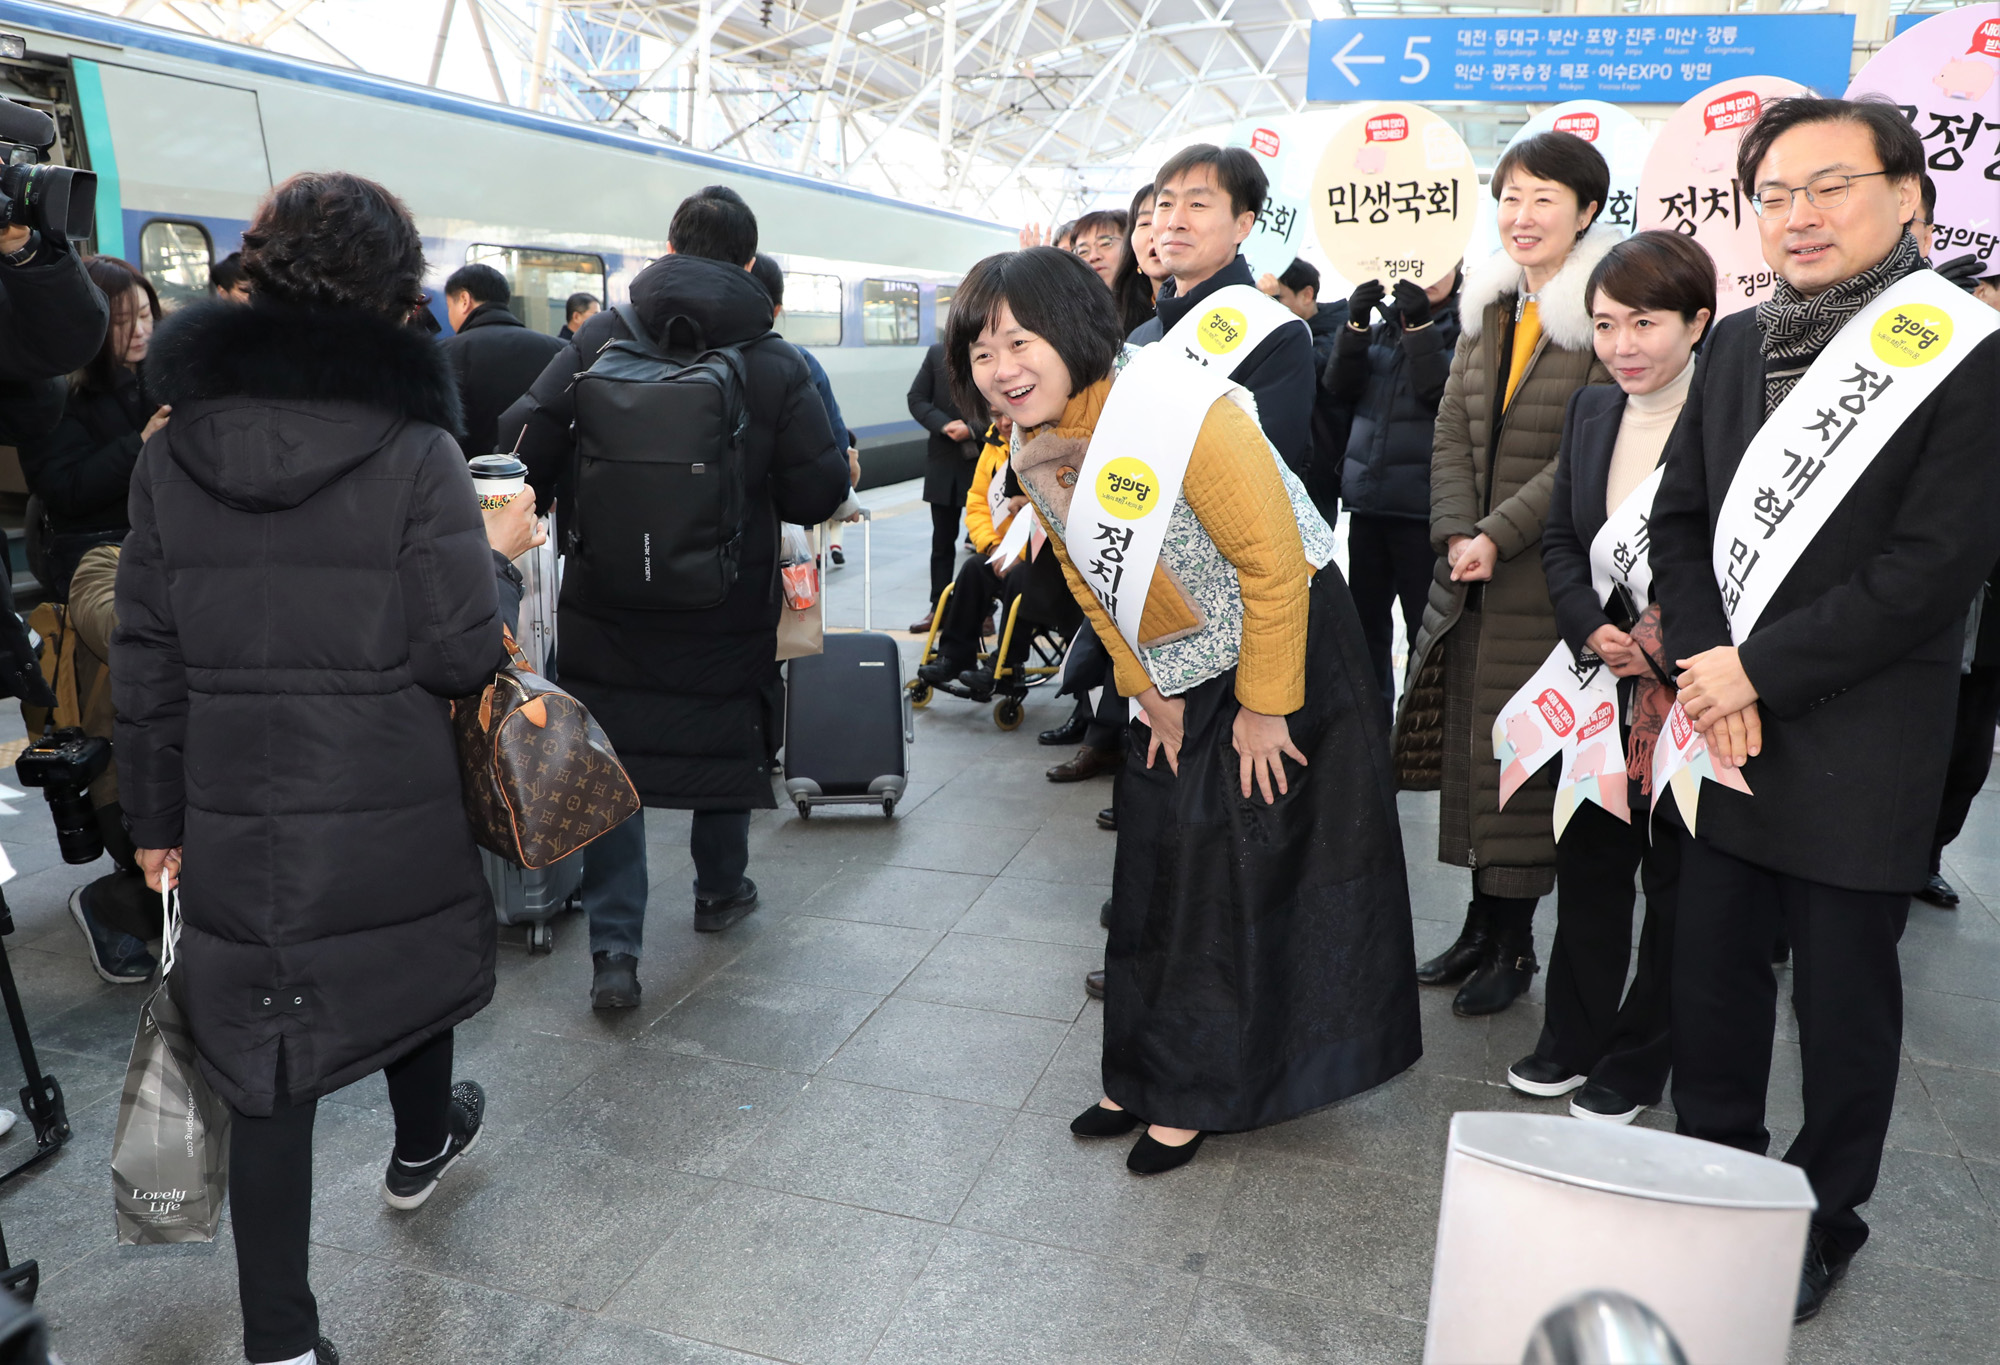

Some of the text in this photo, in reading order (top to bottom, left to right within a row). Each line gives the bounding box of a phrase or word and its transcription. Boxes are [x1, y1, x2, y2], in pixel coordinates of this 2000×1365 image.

[1457, 29, 1487, 47] 대전
[1495, 28, 1539, 47] 동대구
[1548, 28, 1579, 46] 부산
[1586, 27, 1618, 46] 포항
[1626, 27, 1656, 46] 진주
[1665, 27, 1698, 45] 마산
[1400, 35, 1431, 84] 5
[1455, 62, 1712, 82] 익산 광주송정 목포 여수EXPO 방면
[1328, 178, 1459, 224] 민생국회
[1659, 178, 1741, 238] 정치
[1932, 223, 1999, 261] 정의당
[1384, 259, 1425, 278] 정의당
[1738, 271, 1781, 297] 정의
[1210, 313, 1239, 343] 정의당
[1891, 313, 1940, 350] 정의당
[1754, 362, 1894, 540] 정치개혁
[1107, 472, 1151, 501] 정의당
[1086, 522, 1135, 624] 정치개
[1545, 690, 1560, 707] 새해
[1560, 709, 1574, 728] 많이
[132, 1188, 187, 1202] Lovely
[150, 1200, 181, 1215] Life
